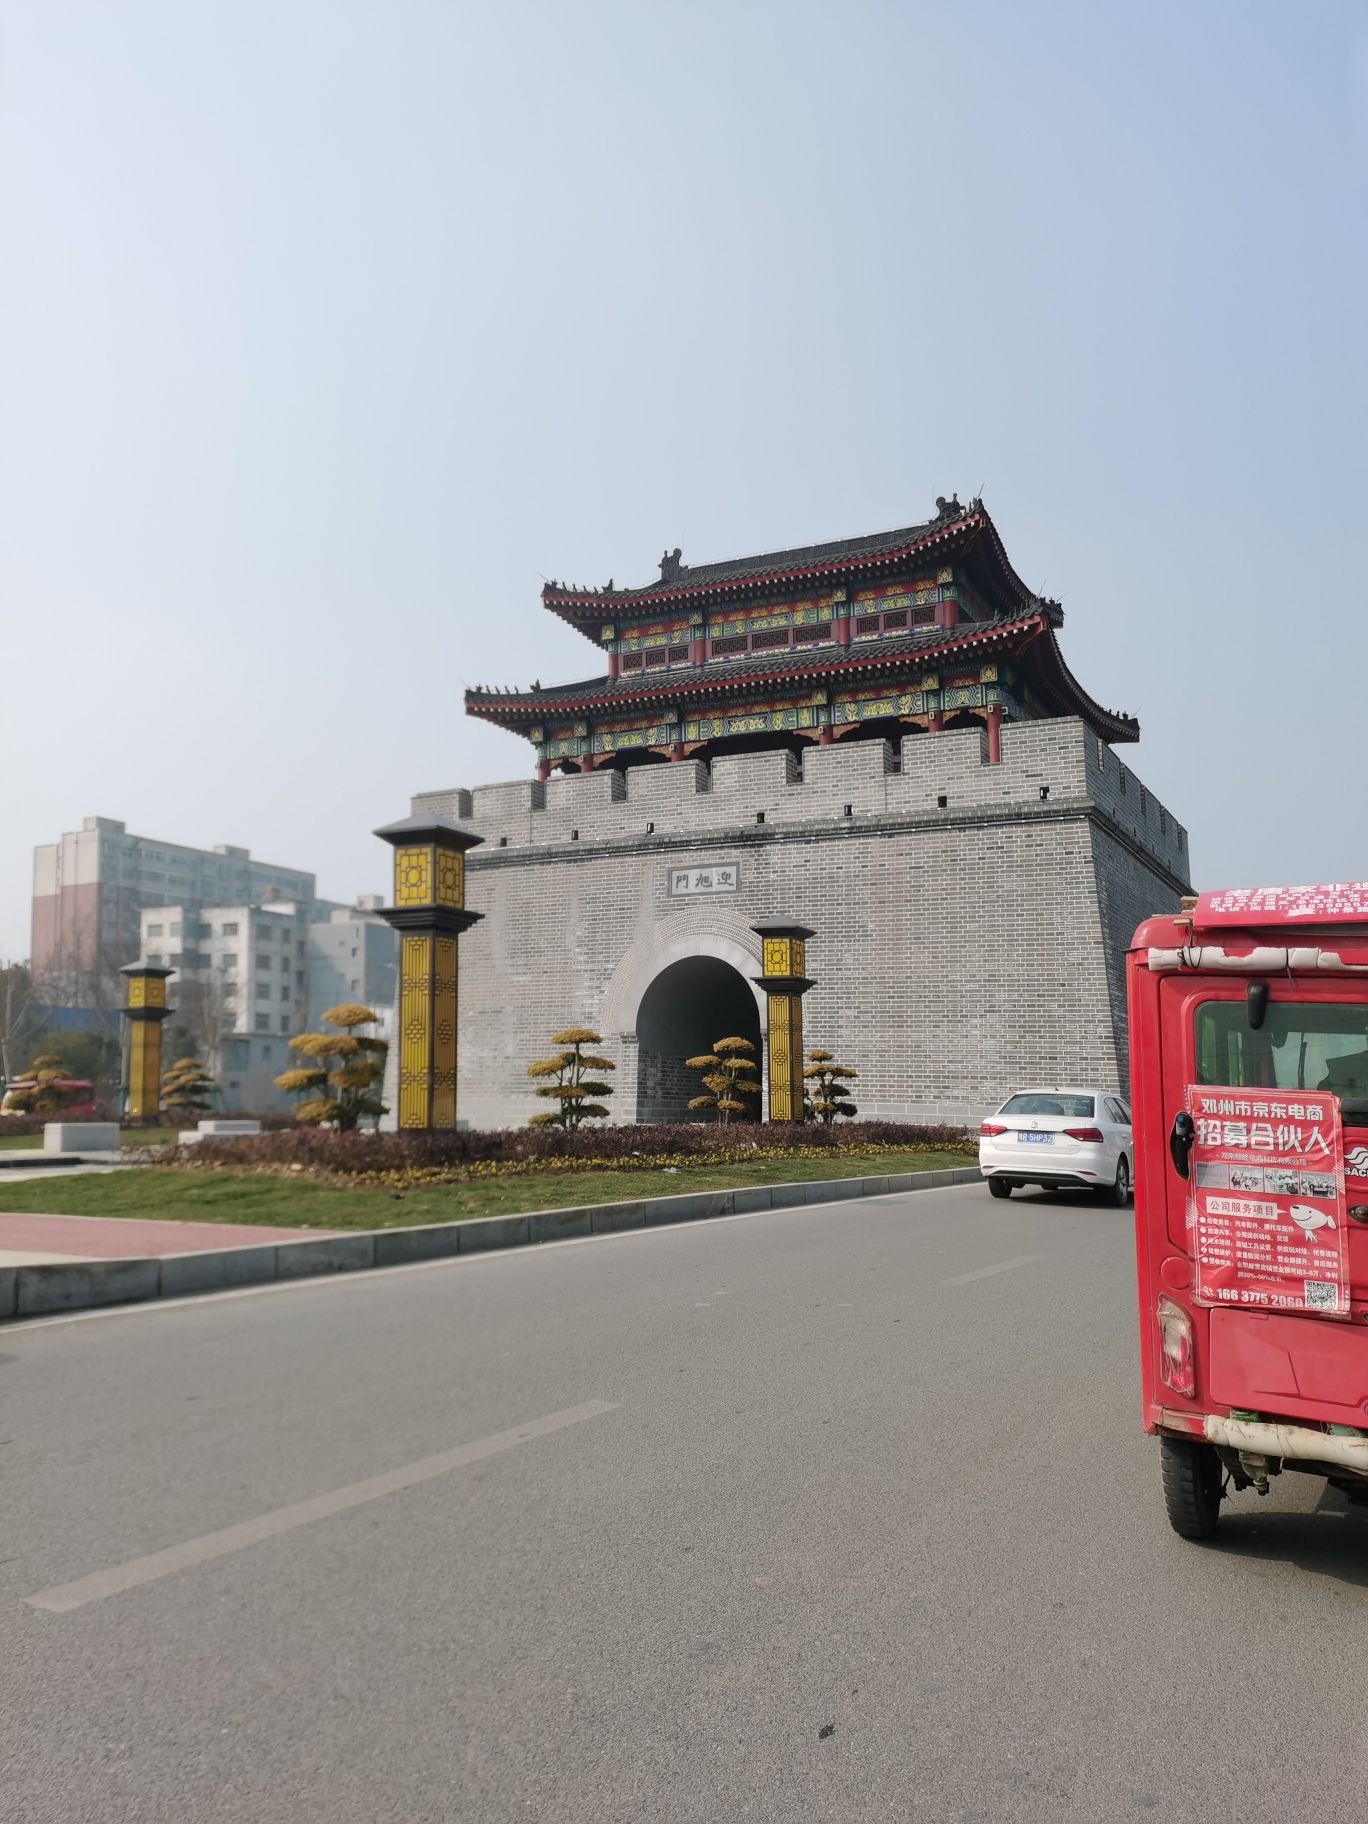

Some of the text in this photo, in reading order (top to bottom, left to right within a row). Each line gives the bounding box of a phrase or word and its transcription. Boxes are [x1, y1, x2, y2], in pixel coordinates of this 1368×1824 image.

[1200, 1098, 1324, 1121] 邓州市京东电商
[1196, 1118, 1331, 1155] 招募合伙人
[1344, 1166, 1368, 1178] SAC
[1210, 1200, 1274, 1216] 公司服务项目
[1216, 1288, 1304, 1308] 166 3775 2060
